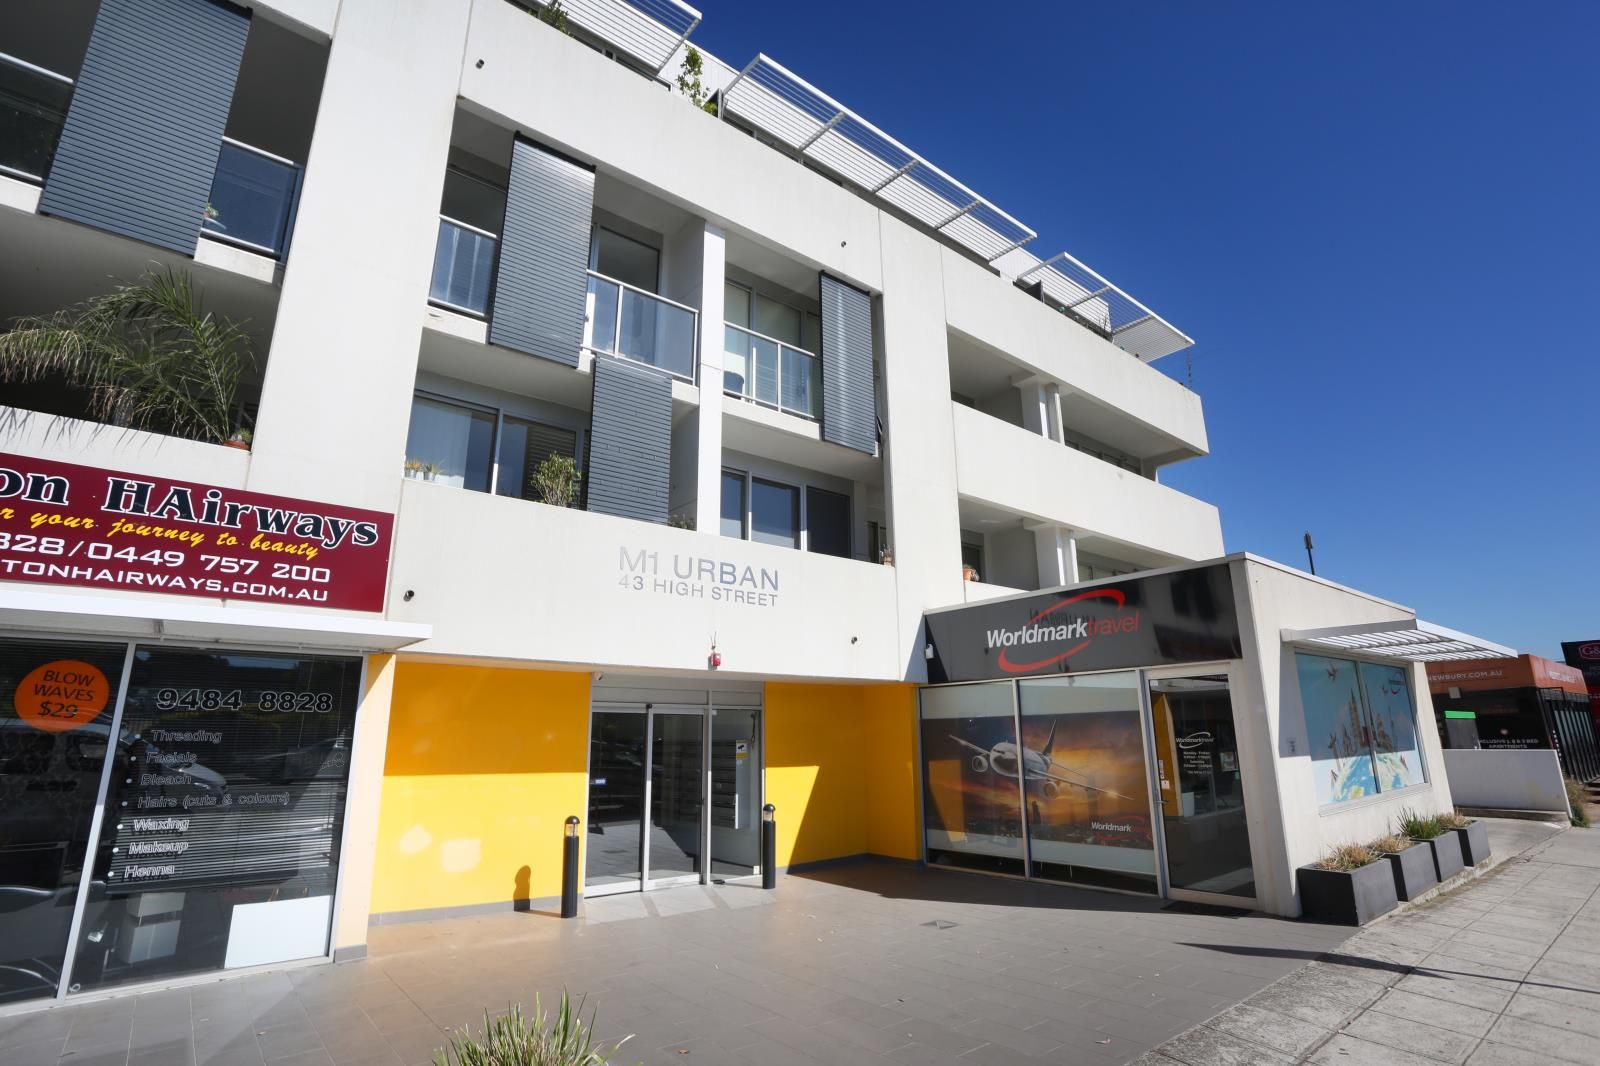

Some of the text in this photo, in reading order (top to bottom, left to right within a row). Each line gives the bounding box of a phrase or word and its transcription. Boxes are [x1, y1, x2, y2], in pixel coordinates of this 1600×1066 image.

[100, 476, 379, 549] HAirways
[30, 512, 95, 529] your
[106, 517, 206, 548] journey
[216, 531, 239, 547] to
[249, 533, 319, 561] beauty
[200, 556, 260, 576] 757
[272, 563, 332, 583] 200
[618, 546, 779, 591] M1 URBAN
[618, 574, 778, 608] 43 HIGH STREET
[43, 669, 95, 685] BLOW
[33, 684, 95, 701] WAVES
[156, 688, 333, 713] 9484 8828
[37, 701, 78, 719] $29
[151, 729, 223, 744] Threading
[146, 751, 198, 764] Facials
[140, 773, 193, 786] Bleach
[222, 793, 233, 805] &
[133, 818, 190, 832] Waxing
[129, 841, 189, 854] Makeup
[124, 864, 175, 878] Henna
